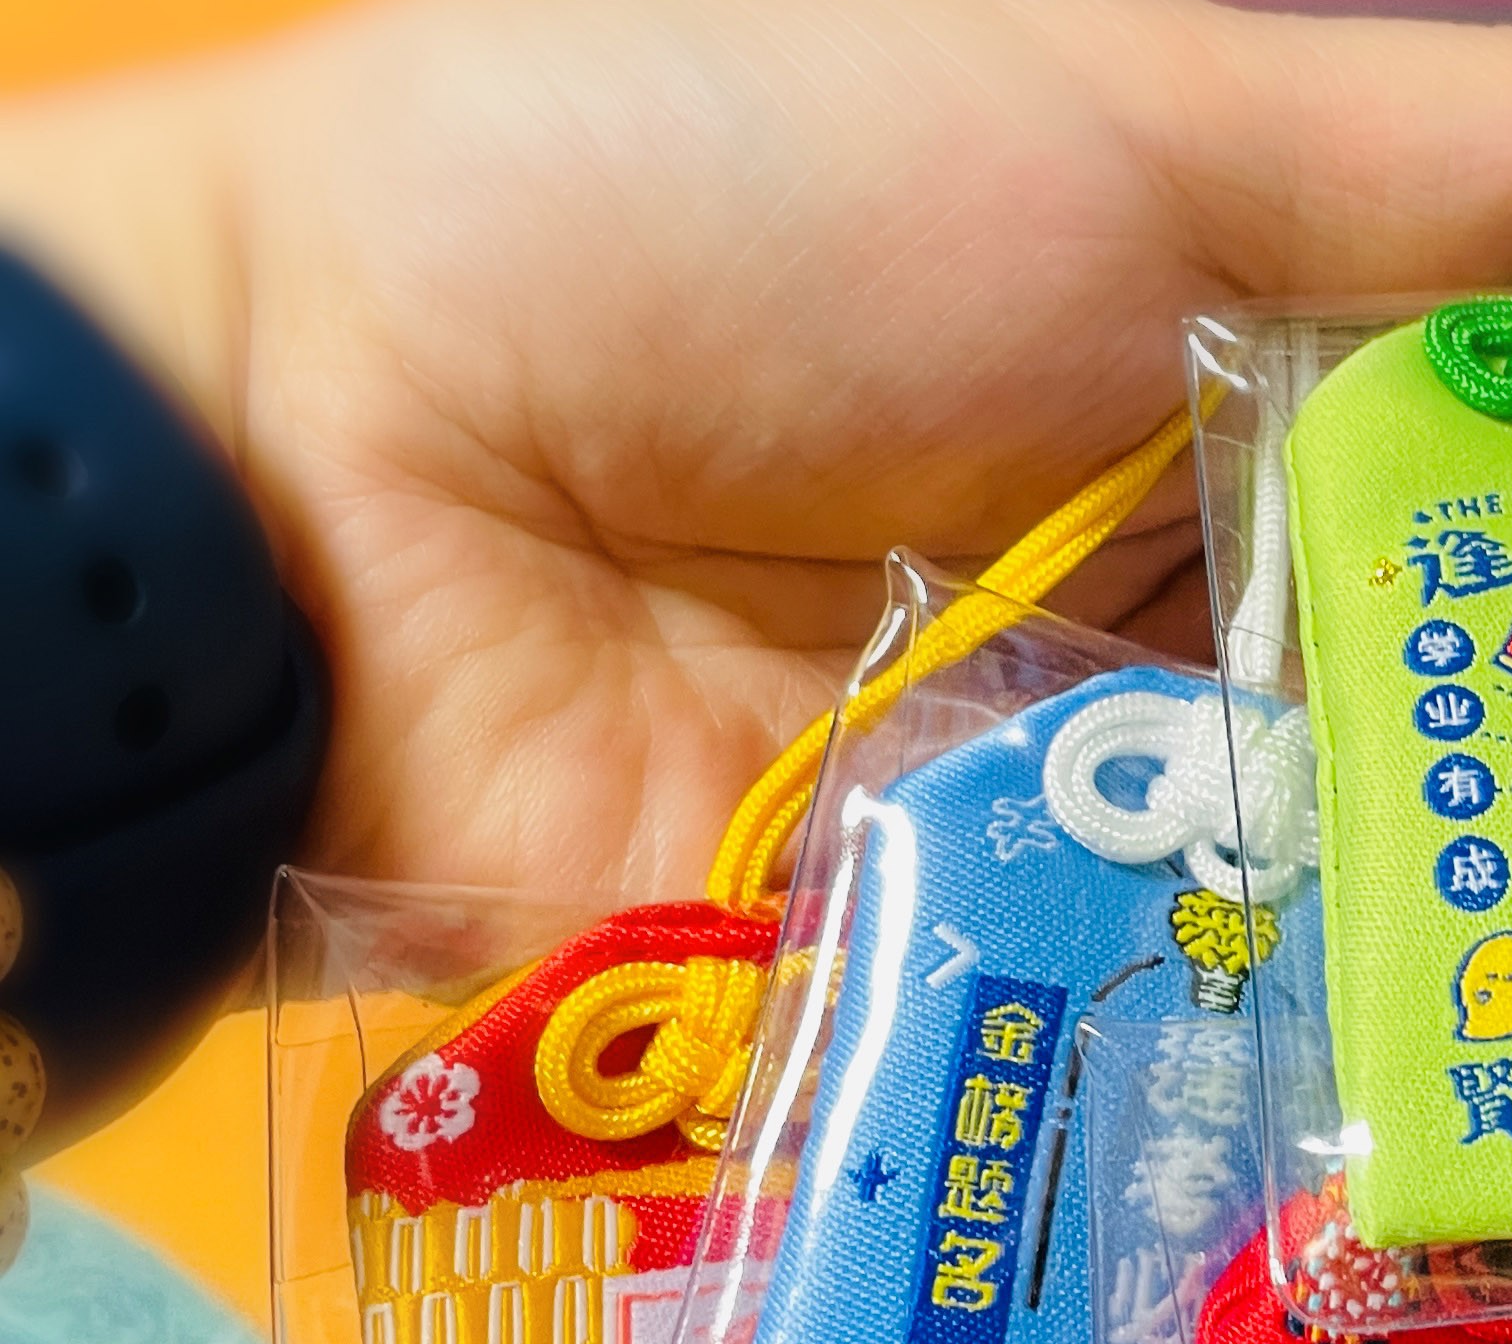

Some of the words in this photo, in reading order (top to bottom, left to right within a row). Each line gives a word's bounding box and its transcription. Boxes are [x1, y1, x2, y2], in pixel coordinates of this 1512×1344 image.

[1435, 494, 1503, 520] THE
[1416, 626, 1503, 894] 学业有成
[931, 1001, 1044, 1312] 金榜题名
